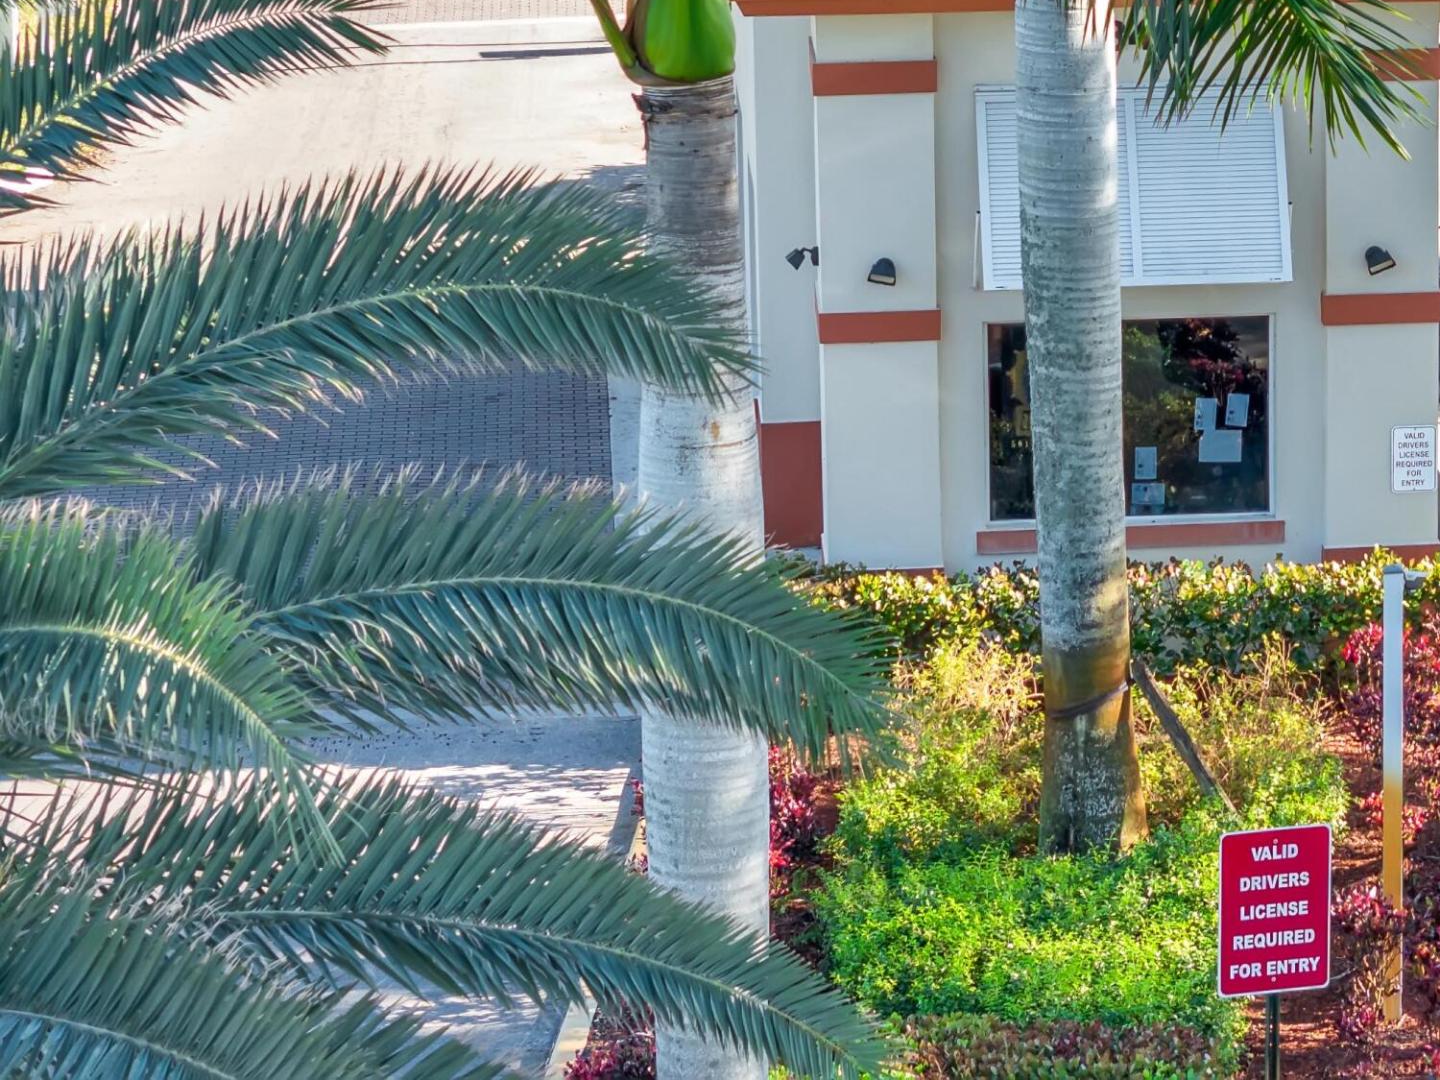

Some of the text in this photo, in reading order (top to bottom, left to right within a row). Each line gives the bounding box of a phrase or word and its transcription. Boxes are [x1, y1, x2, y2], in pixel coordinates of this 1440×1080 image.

[1398, 441, 1429, 449] DRIVERS
[1399, 450, 1430, 459] LICENSE
[1395, 460, 1433, 468] REQUIRED
[1406, 469, 1422, 477] FOR
[1401, 479, 1425, 487] ENTRY
[1251, 843, 1299, 862] VALID
[1239, 871, 1310, 892] DRIVERS
[1240, 900, 1309, 921] LICENSE
[1233, 928, 1315, 951] REQUIRED
[1229, 956, 1321, 980] FOR ENTRY
